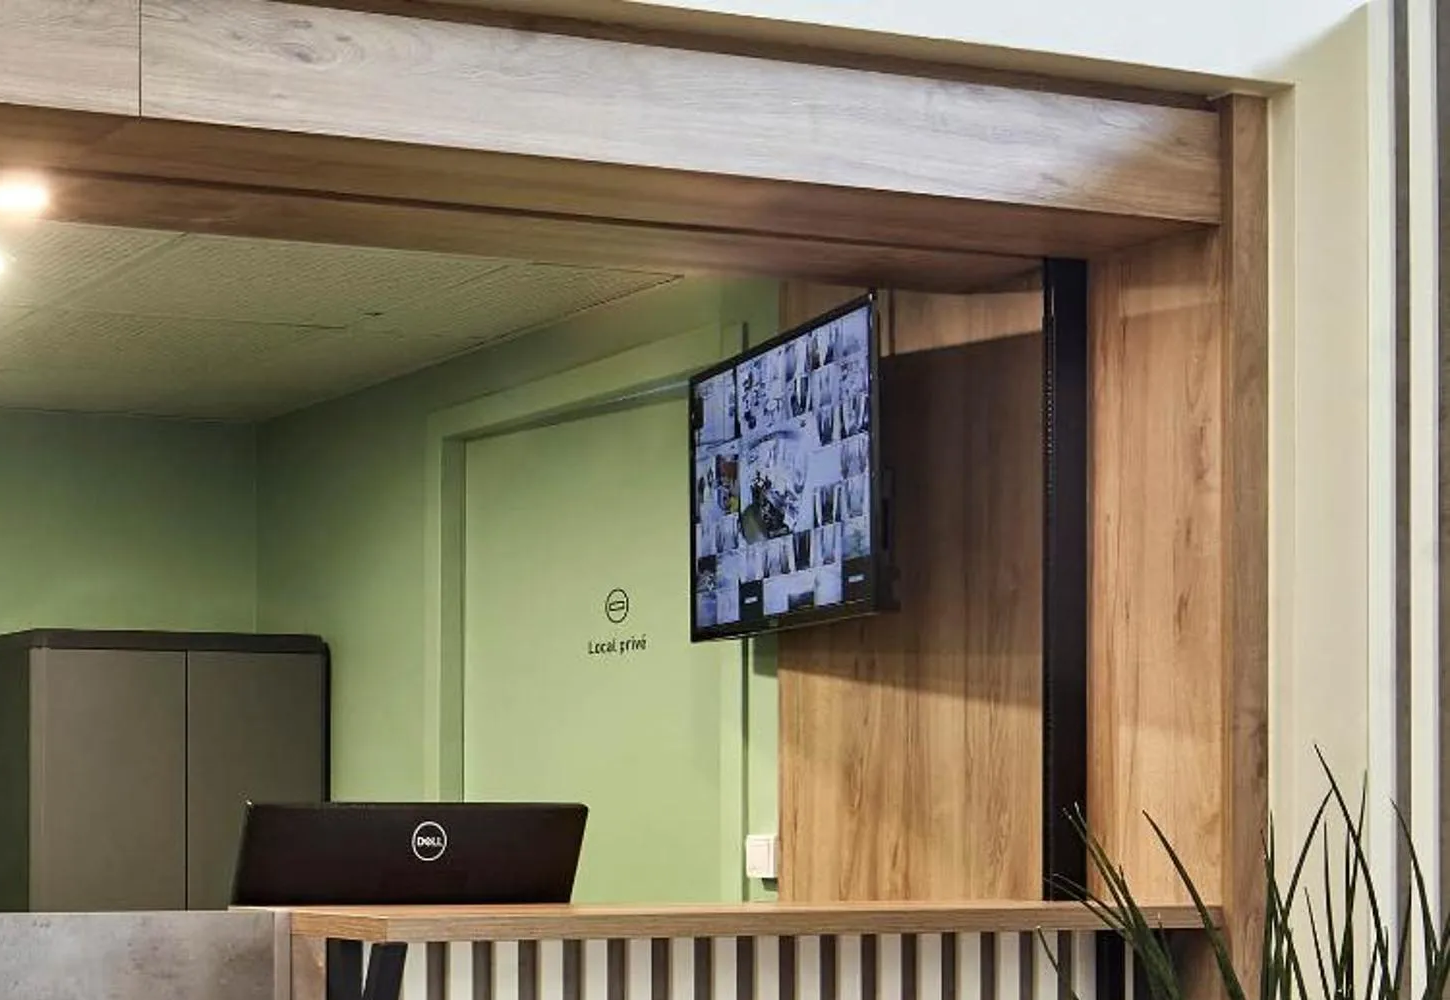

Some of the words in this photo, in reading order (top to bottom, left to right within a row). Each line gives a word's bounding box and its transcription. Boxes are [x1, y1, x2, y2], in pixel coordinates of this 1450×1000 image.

[587, 638, 618, 655] Local
[619, 633, 647, 656] privé
[416, 836, 444, 848] DELL
